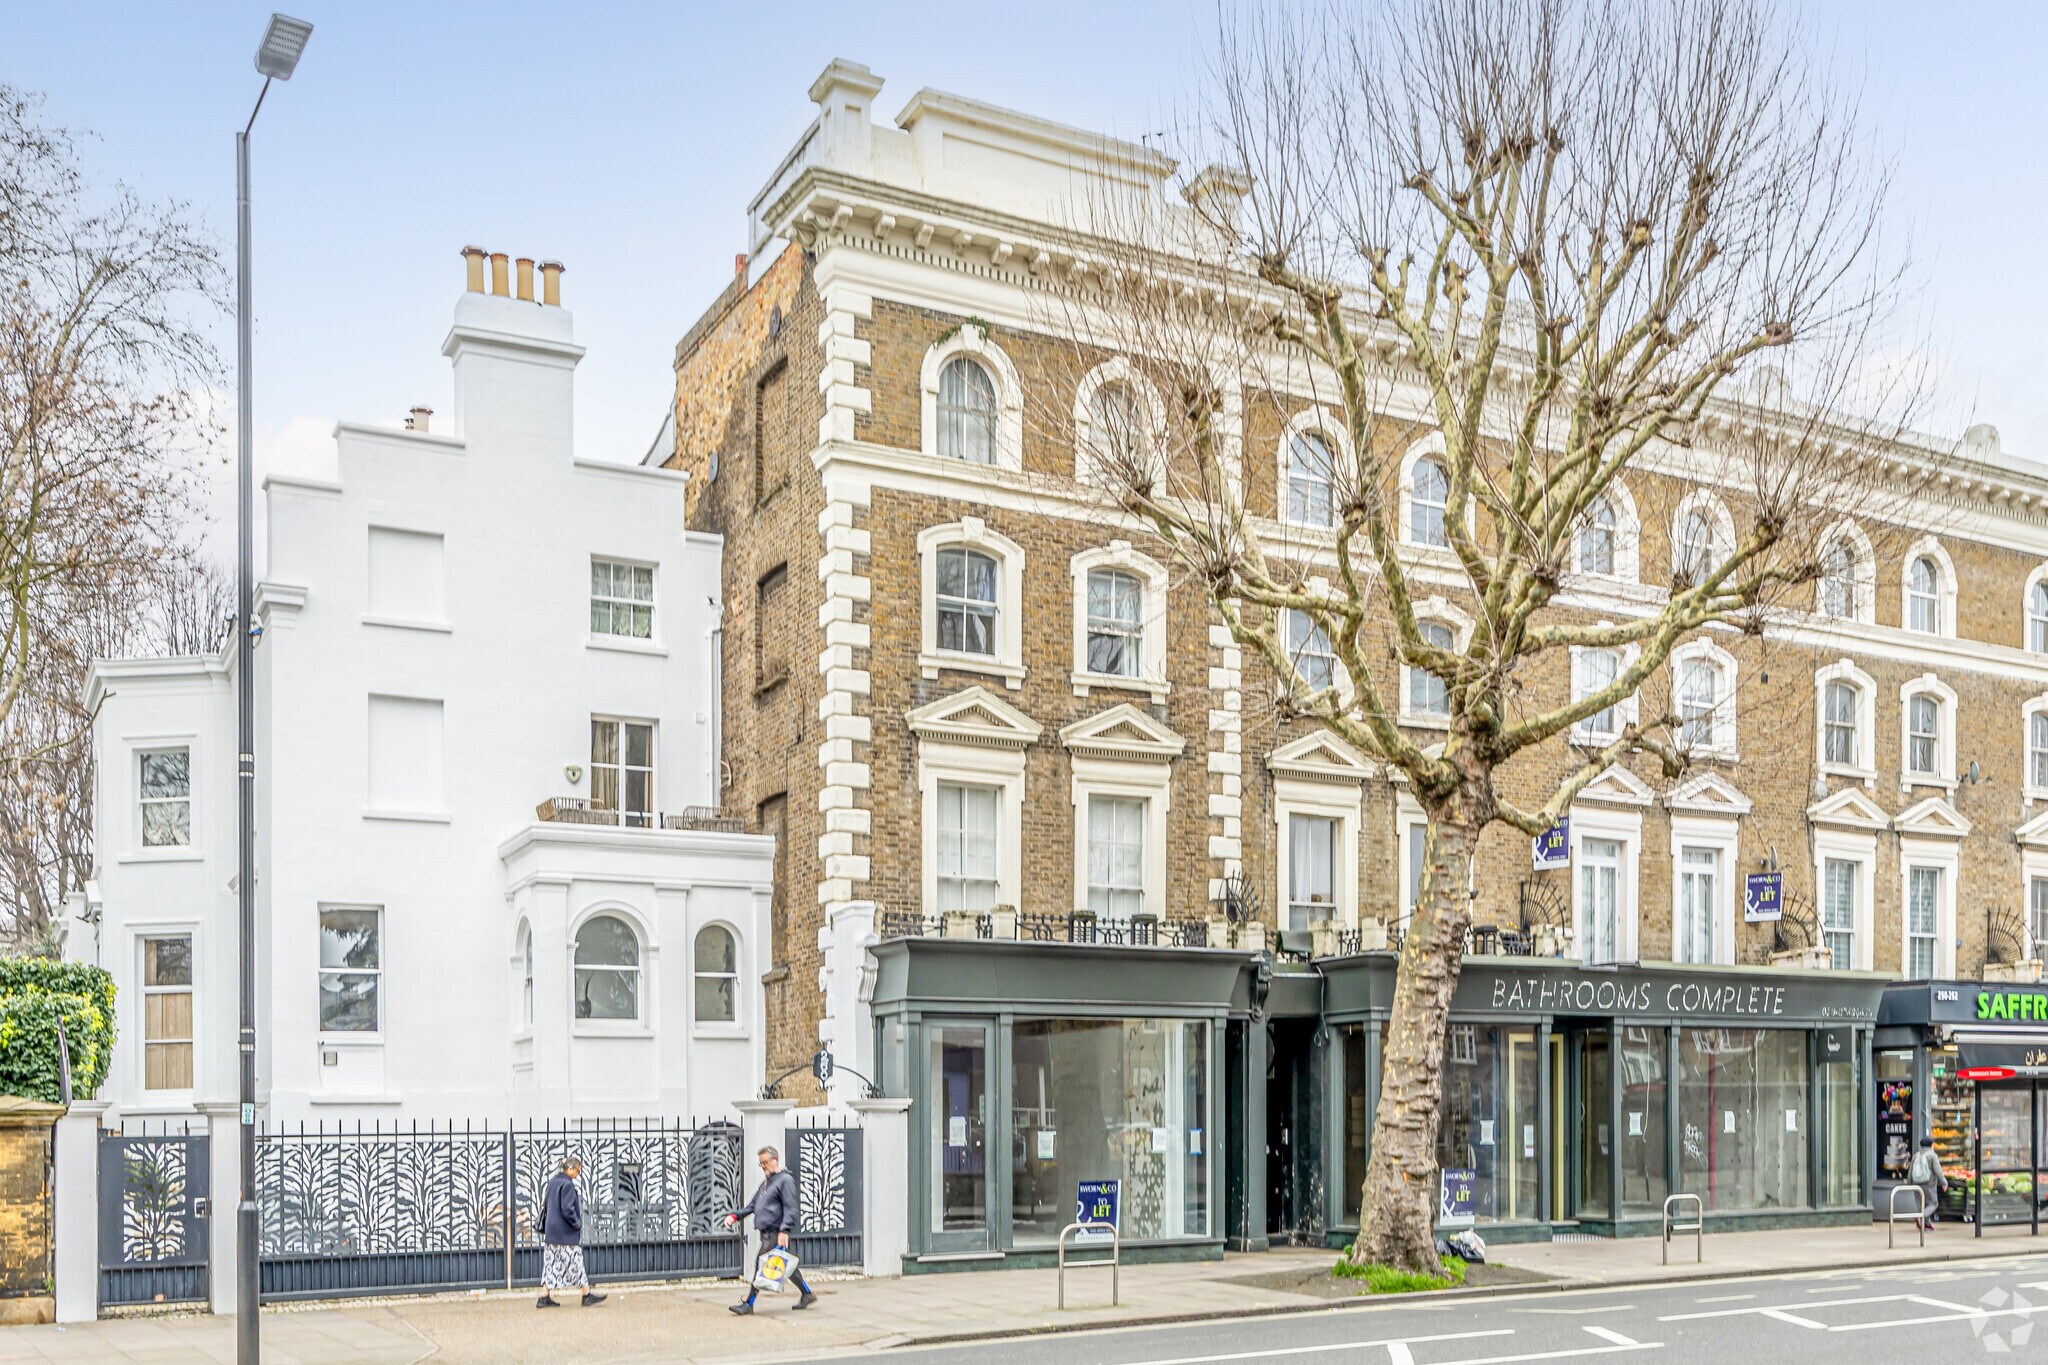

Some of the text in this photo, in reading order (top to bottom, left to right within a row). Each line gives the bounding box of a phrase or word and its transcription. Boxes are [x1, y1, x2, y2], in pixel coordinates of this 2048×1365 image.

[1549, 835, 1564, 848] LET
[1760, 891, 1776, 902] LET
[1492, 977, 1786, 1015] BATHROOMS COMPLETE
[1977, 992, 2048, 1020] SAFFR
[1885, 1122, 1907, 1134] CAKES
[1456, 1190, 1470, 1201] LET
[1097, 1198, 1108, 1206] TO
[1093, 1204, 1111, 1217] LET
